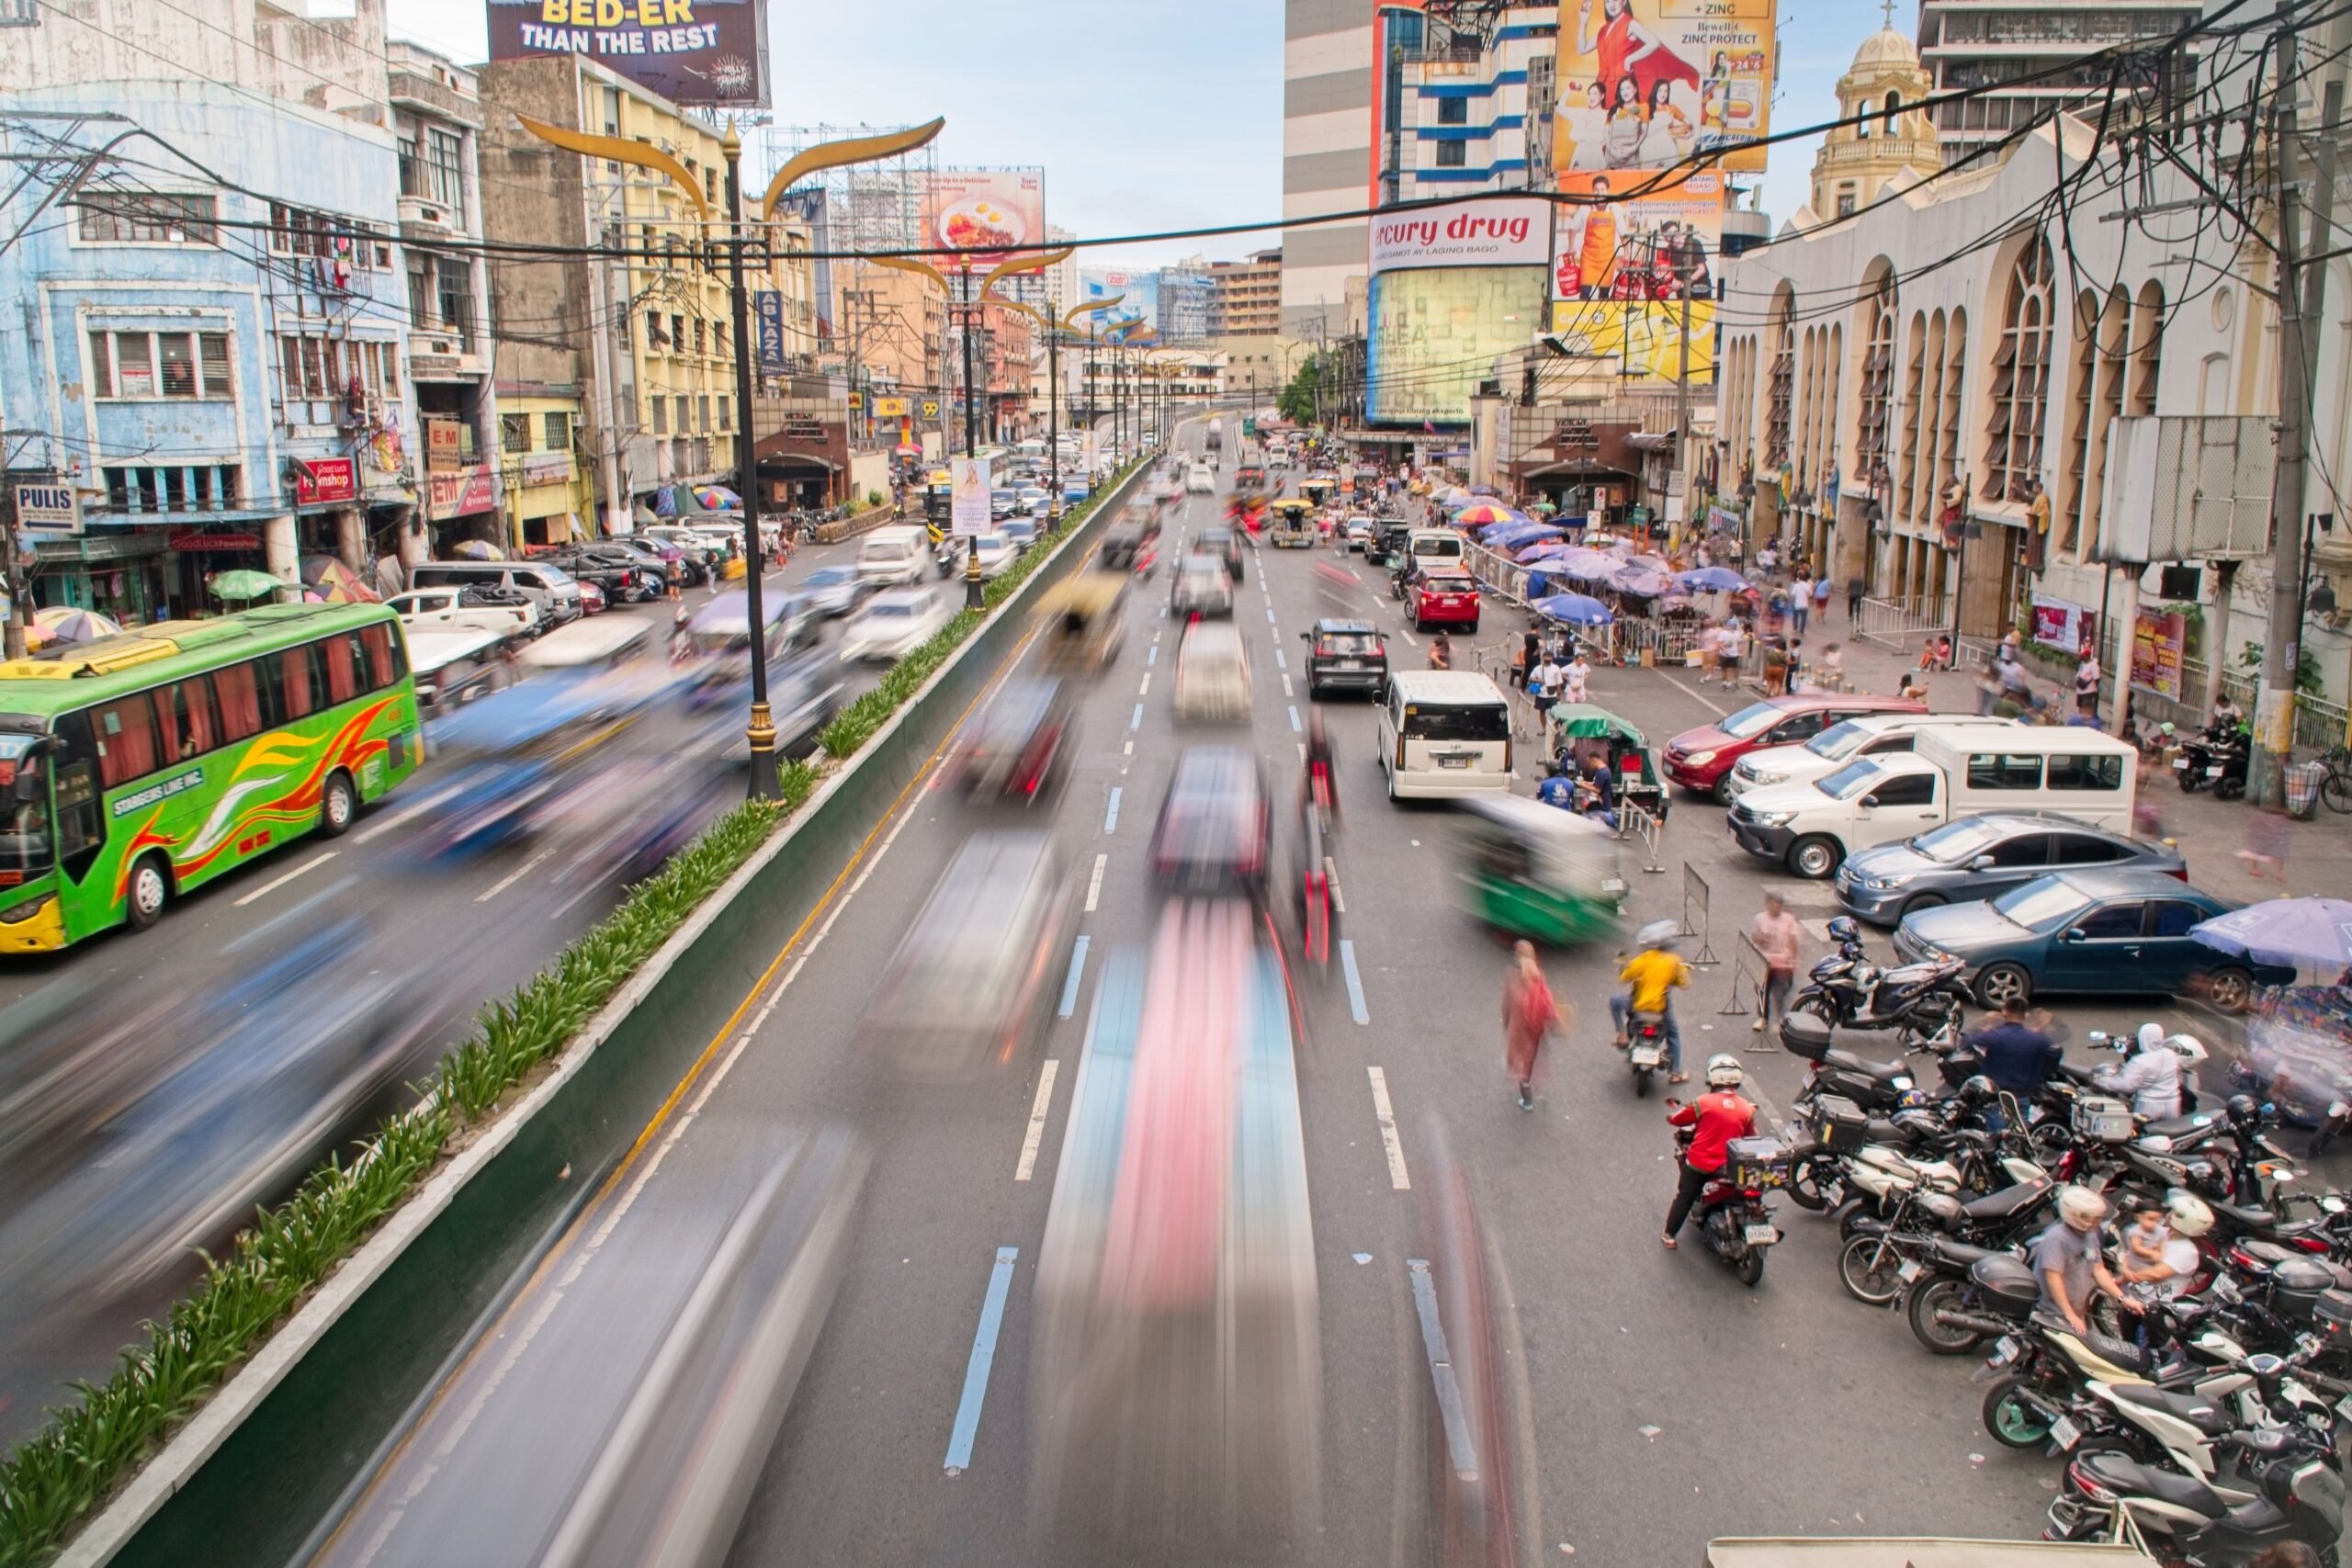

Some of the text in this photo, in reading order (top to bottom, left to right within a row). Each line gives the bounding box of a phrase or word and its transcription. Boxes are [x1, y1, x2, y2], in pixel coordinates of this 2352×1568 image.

[542, 0, 695, 27] BED-ER
[1706, 5, 1736, 15] ZINC
[522, 23, 718, 54] THAN THE REST
[1681, 34, 1758, 45] ZINC PROTECT
[1447, 213, 1530, 243] drug
[762, 293, 780, 362] ABLAZA
[19, 489, 72, 510] PULIS
